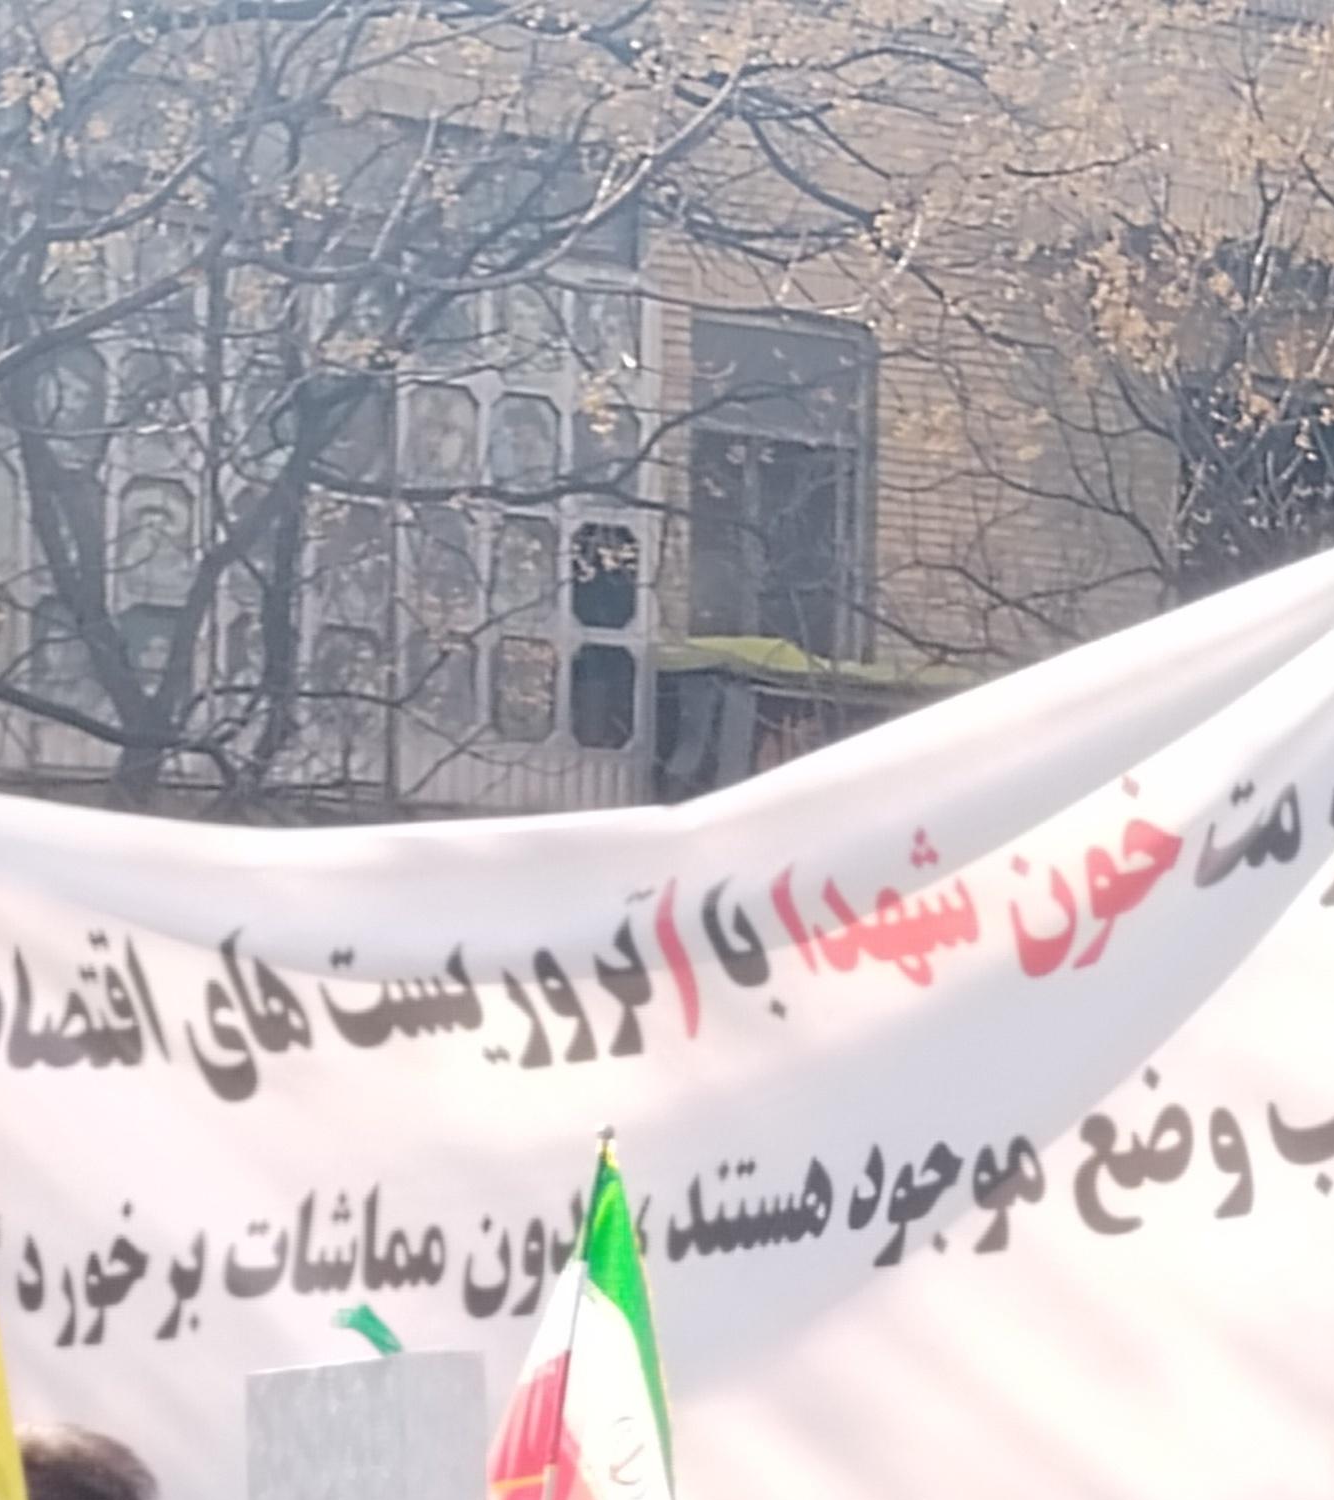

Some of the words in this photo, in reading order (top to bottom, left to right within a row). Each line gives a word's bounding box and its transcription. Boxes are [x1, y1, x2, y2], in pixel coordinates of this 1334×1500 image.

[701, 873, 787, 1020] با
[769, 824, 981, 987] شهدا
[1009, 773, 1185, 978] خون
[185, 926, 313, 1104] های
[847, 1134, 1047, 1269] موجود
[1073, 1065, 1257, 1236] وضع
[223, 1184, 447, 1300] مماشات
[463, 1184, 586, 1319] دون
